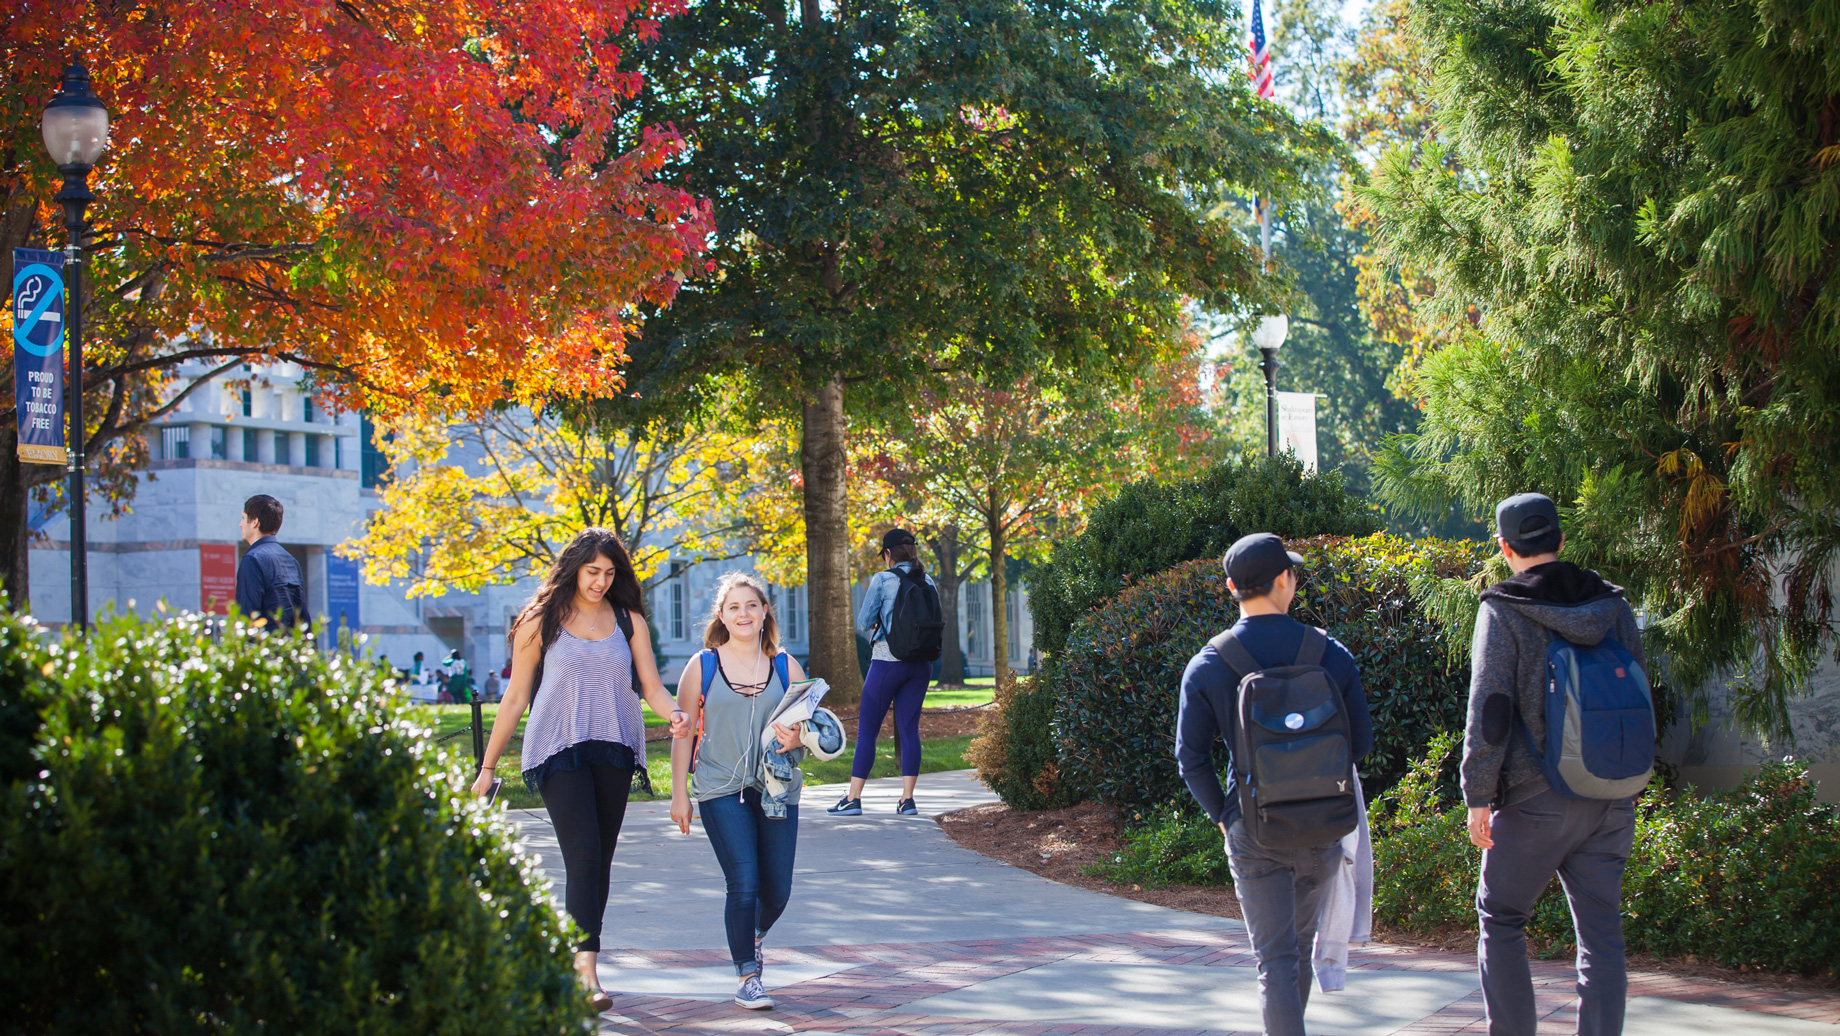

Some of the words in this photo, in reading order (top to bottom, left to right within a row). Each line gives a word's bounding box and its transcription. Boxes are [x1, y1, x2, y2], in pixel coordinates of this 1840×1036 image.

[28, 371, 54, 383] PROUD
[31, 386, 41, 397] TO
[42, 388, 52, 398] BE
[25, 401, 57, 415] TOBACCO
[31, 417, 50, 429] FREE
[26, 448, 58, 460] EMORY
